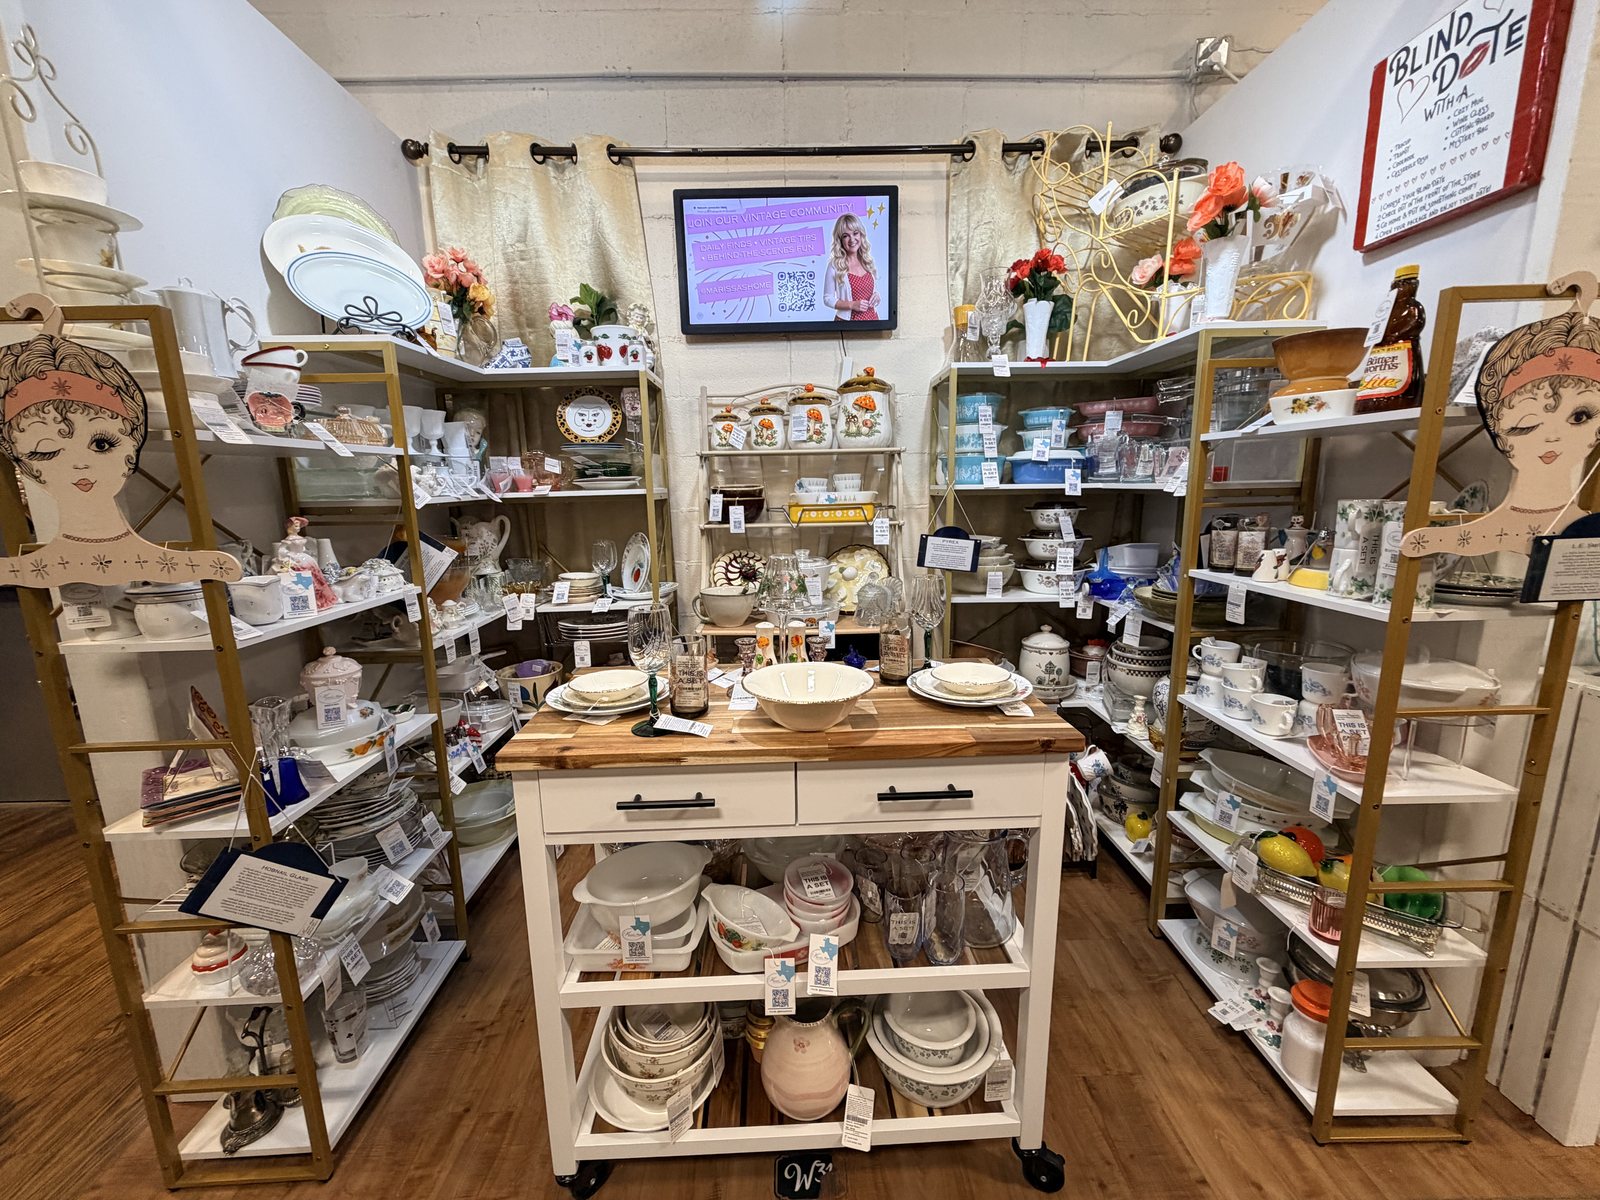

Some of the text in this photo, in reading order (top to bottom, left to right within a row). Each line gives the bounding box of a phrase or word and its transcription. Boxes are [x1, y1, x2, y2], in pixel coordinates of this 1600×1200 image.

[1389, 10, 1473, 87] BLIND
[1432, 9, 1527, 97] DTE
[1424, 93, 1454, 122] WITH
[1452, 104, 1489, 128] WINE GLASS
[1454, 96, 1484, 117] COZY MUG
[1450, 112, 1494, 138] CUTTING BOARD
[1448, 125, 1488, 150] MYSTERY BAG
[1391, 155, 1428, 178] CASSEROLE DISH
[1392, 154, 1414, 168] COOKBOOK
[1382, 210, 1396, 220] CHECK
[1397, 202, 1407, 212] OUT
[1414, 196, 1424, 206] THE
[1425, 186, 1442, 200] FRONT
[1449, 178, 1460, 190] THE
[1460, 170, 1481, 186] STORE
[1383, 198, 1400, 210] CHOOSE
[1402, 192, 1415, 200] YOUR
[1416, 184, 1431, 196] BLIND
[1431, 176, 1446, 188] DATE
[1458, 182, 1477, 195] COMFY
[688, 203, 854, 228] JOIN OUR VINTAGE COMMUNITY!
[700, 244, 724, 252] DAILY
[727, 241, 752, 250] FINDS
[760, 236, 796, 246] VINTAGE
[796, 244, 814, 252] FUN
[1371, 536, 1379, 554] THIS
[261, 865, 309, 882] HOBNAIL GLASS
[343, 950, 353, 962] THIS
[350, 949, 361, 962] SET
